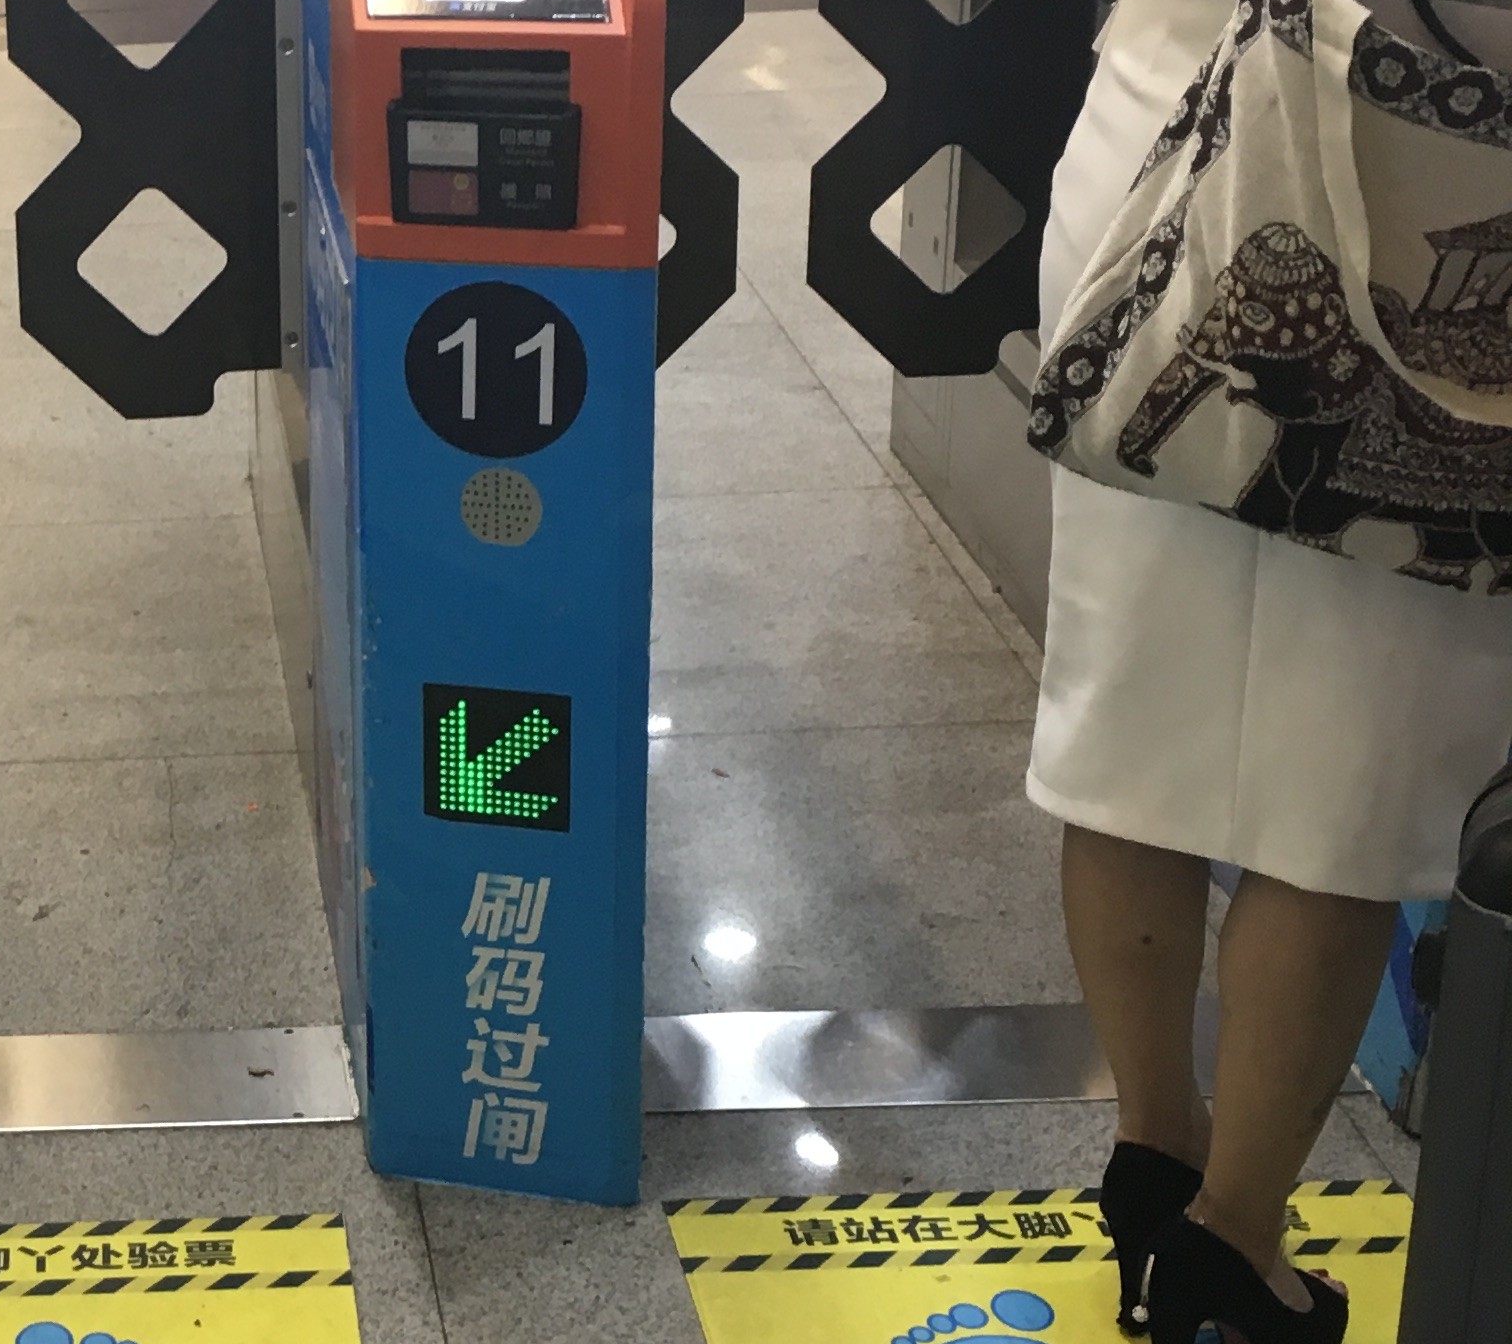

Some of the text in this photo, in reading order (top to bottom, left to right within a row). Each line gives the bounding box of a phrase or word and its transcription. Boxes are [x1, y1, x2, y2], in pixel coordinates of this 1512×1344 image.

[437, 317, 556, 426] 11
[461, 871, 552, 1166] 刷码过闸
